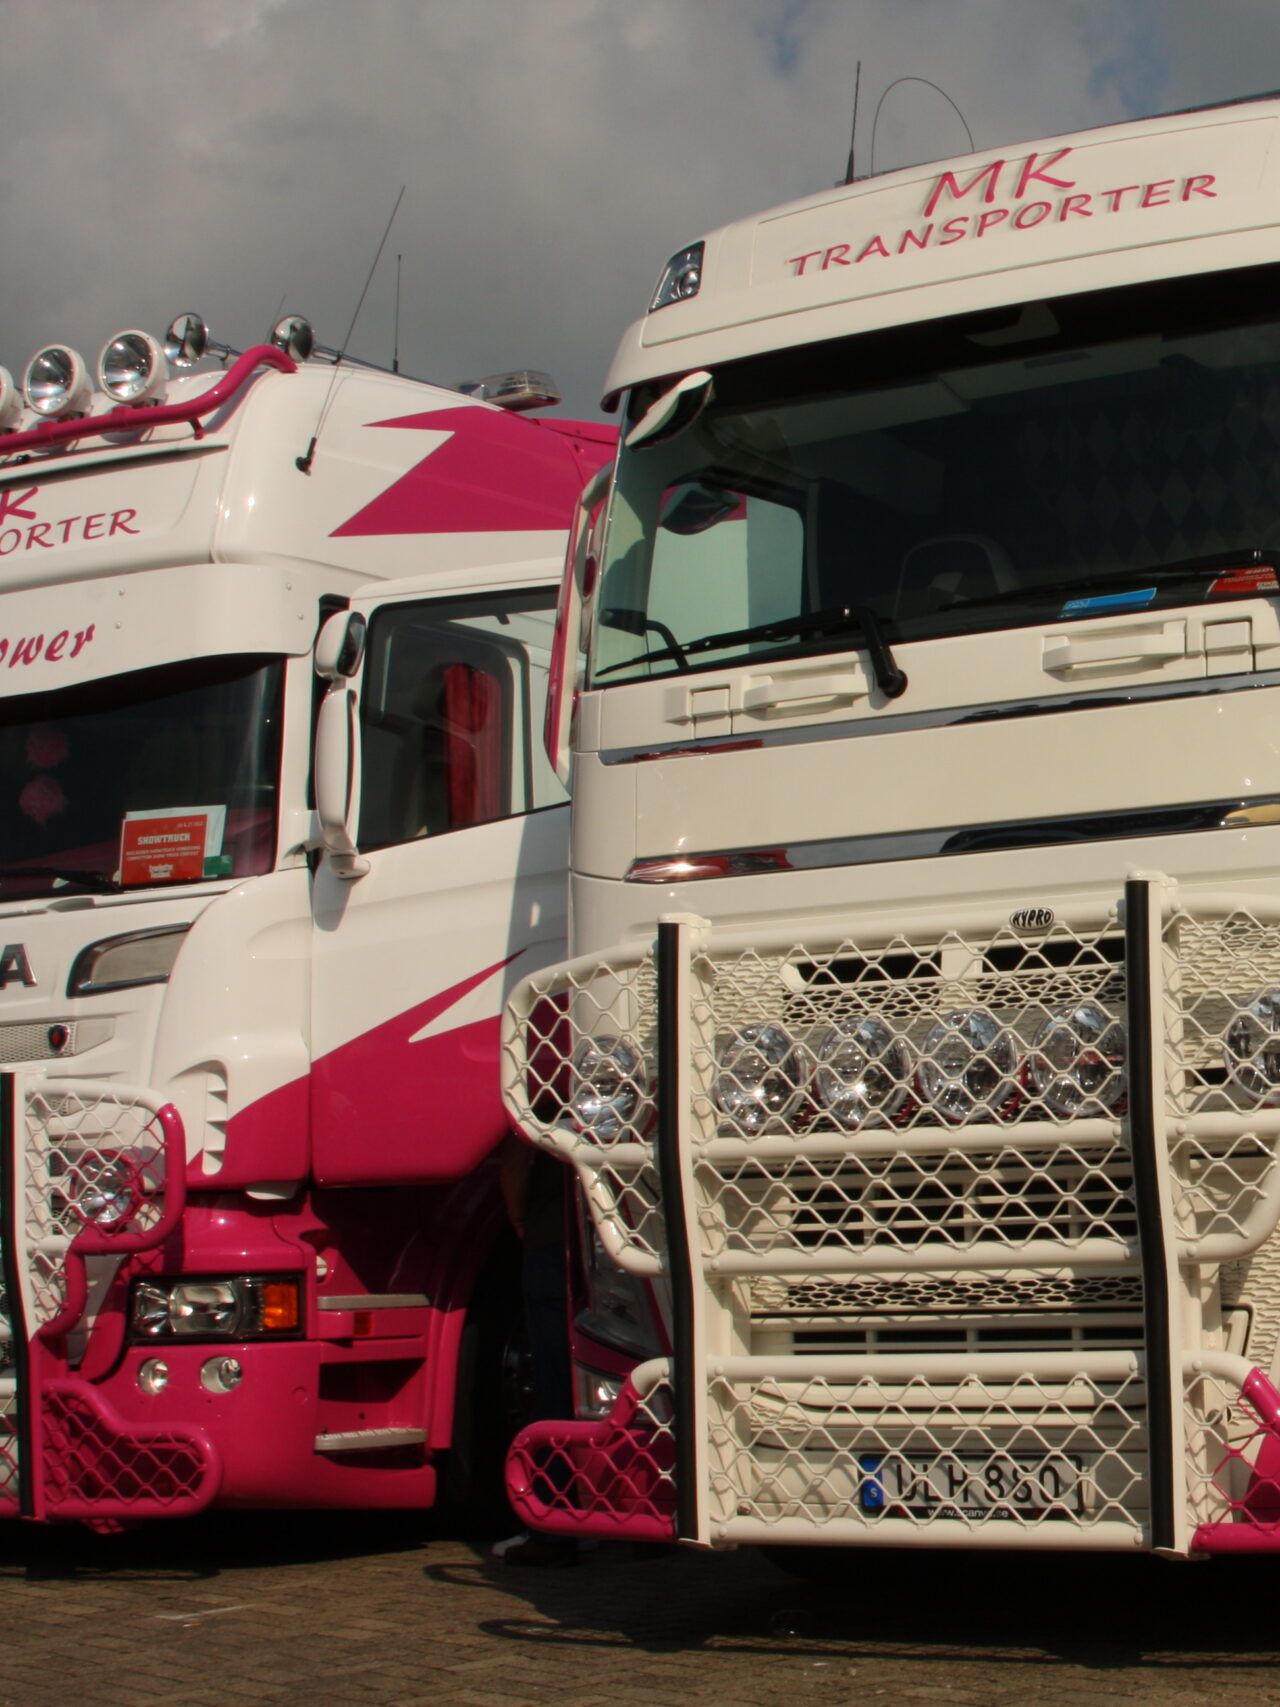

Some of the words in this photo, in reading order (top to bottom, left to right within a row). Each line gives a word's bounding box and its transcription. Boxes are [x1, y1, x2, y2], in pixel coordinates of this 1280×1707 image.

[923, 147, 1076, 217] MK
[789, 175, 1218, 276] TRANSPORTER
[137, 833, 191, 846] SHOWTRUCK
